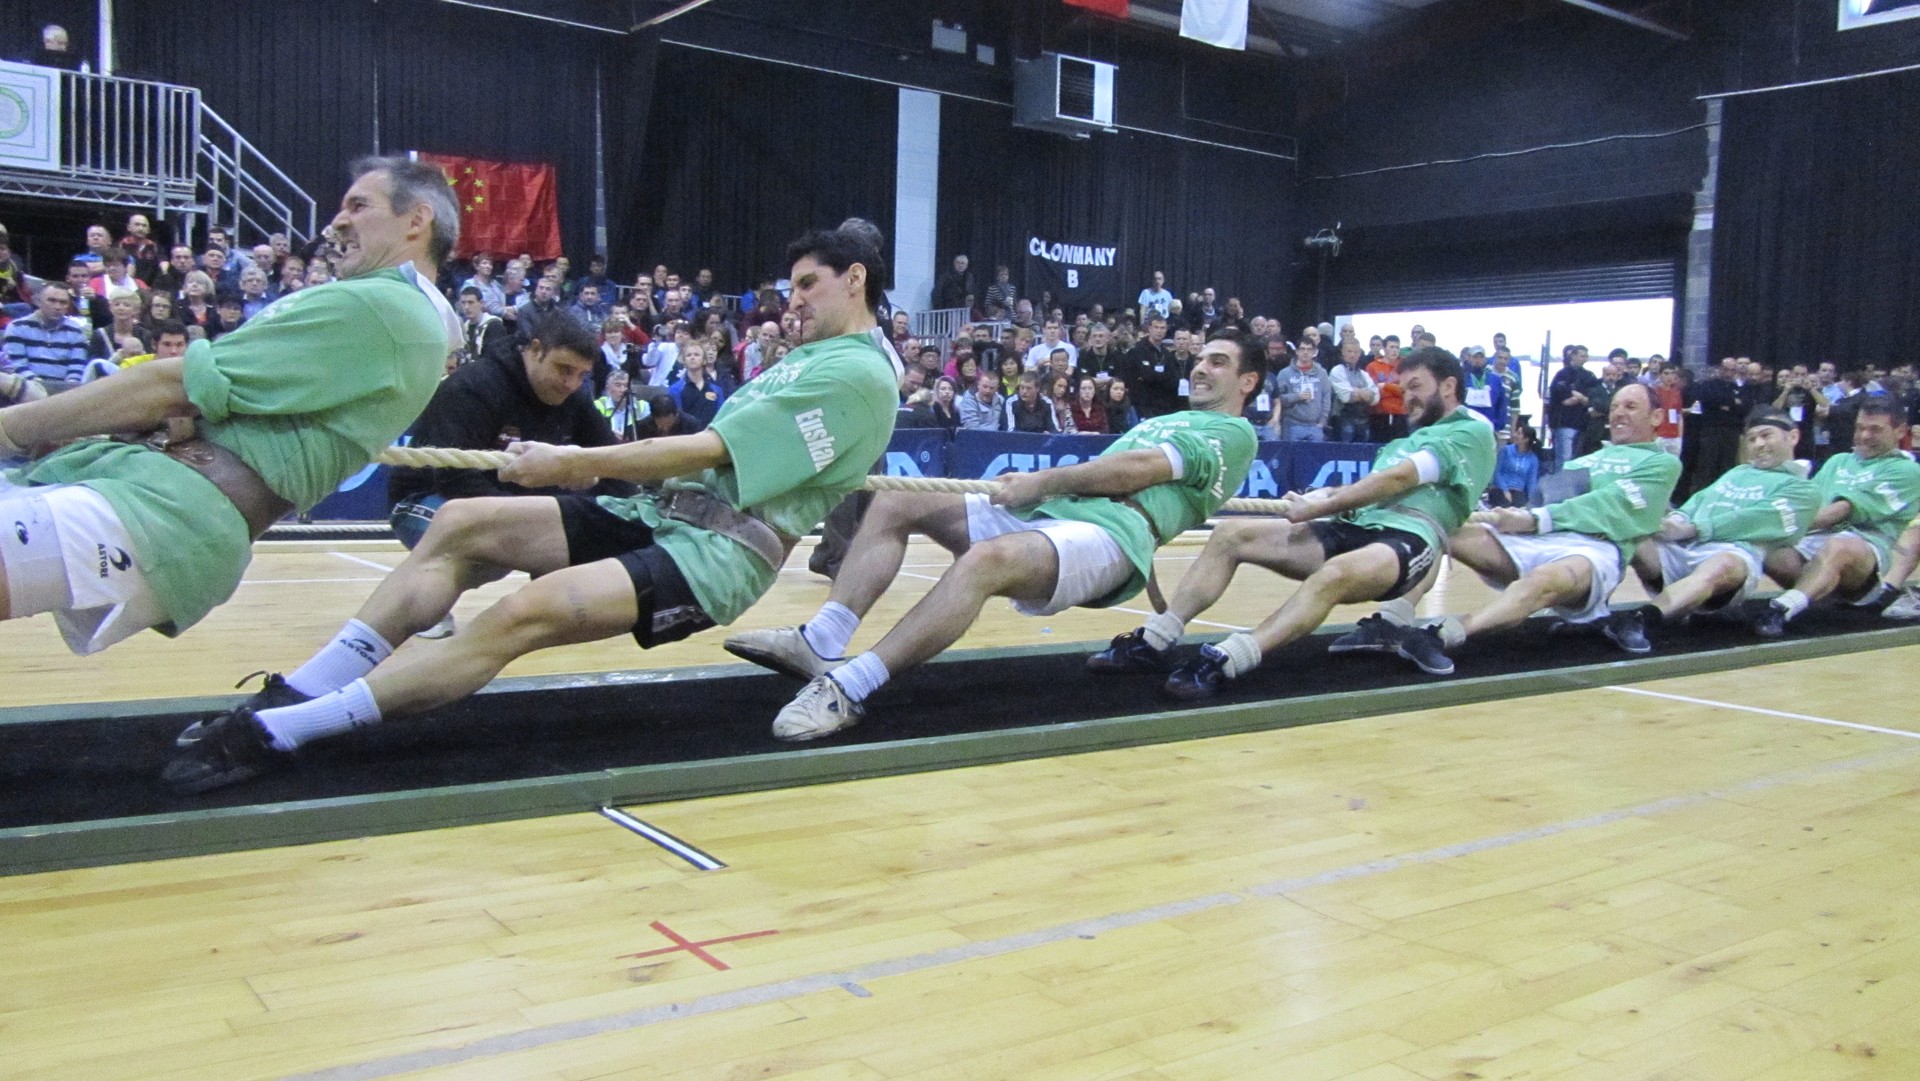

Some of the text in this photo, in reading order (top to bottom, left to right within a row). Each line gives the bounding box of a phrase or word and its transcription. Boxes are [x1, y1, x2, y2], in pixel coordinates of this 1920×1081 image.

[1029, 237, 1116, 266] CLONMANY
[1066, 269, 1079, 288] B
[795, 408, 835, 473] Euska
[97, 543, 109, 578] ASTORE
